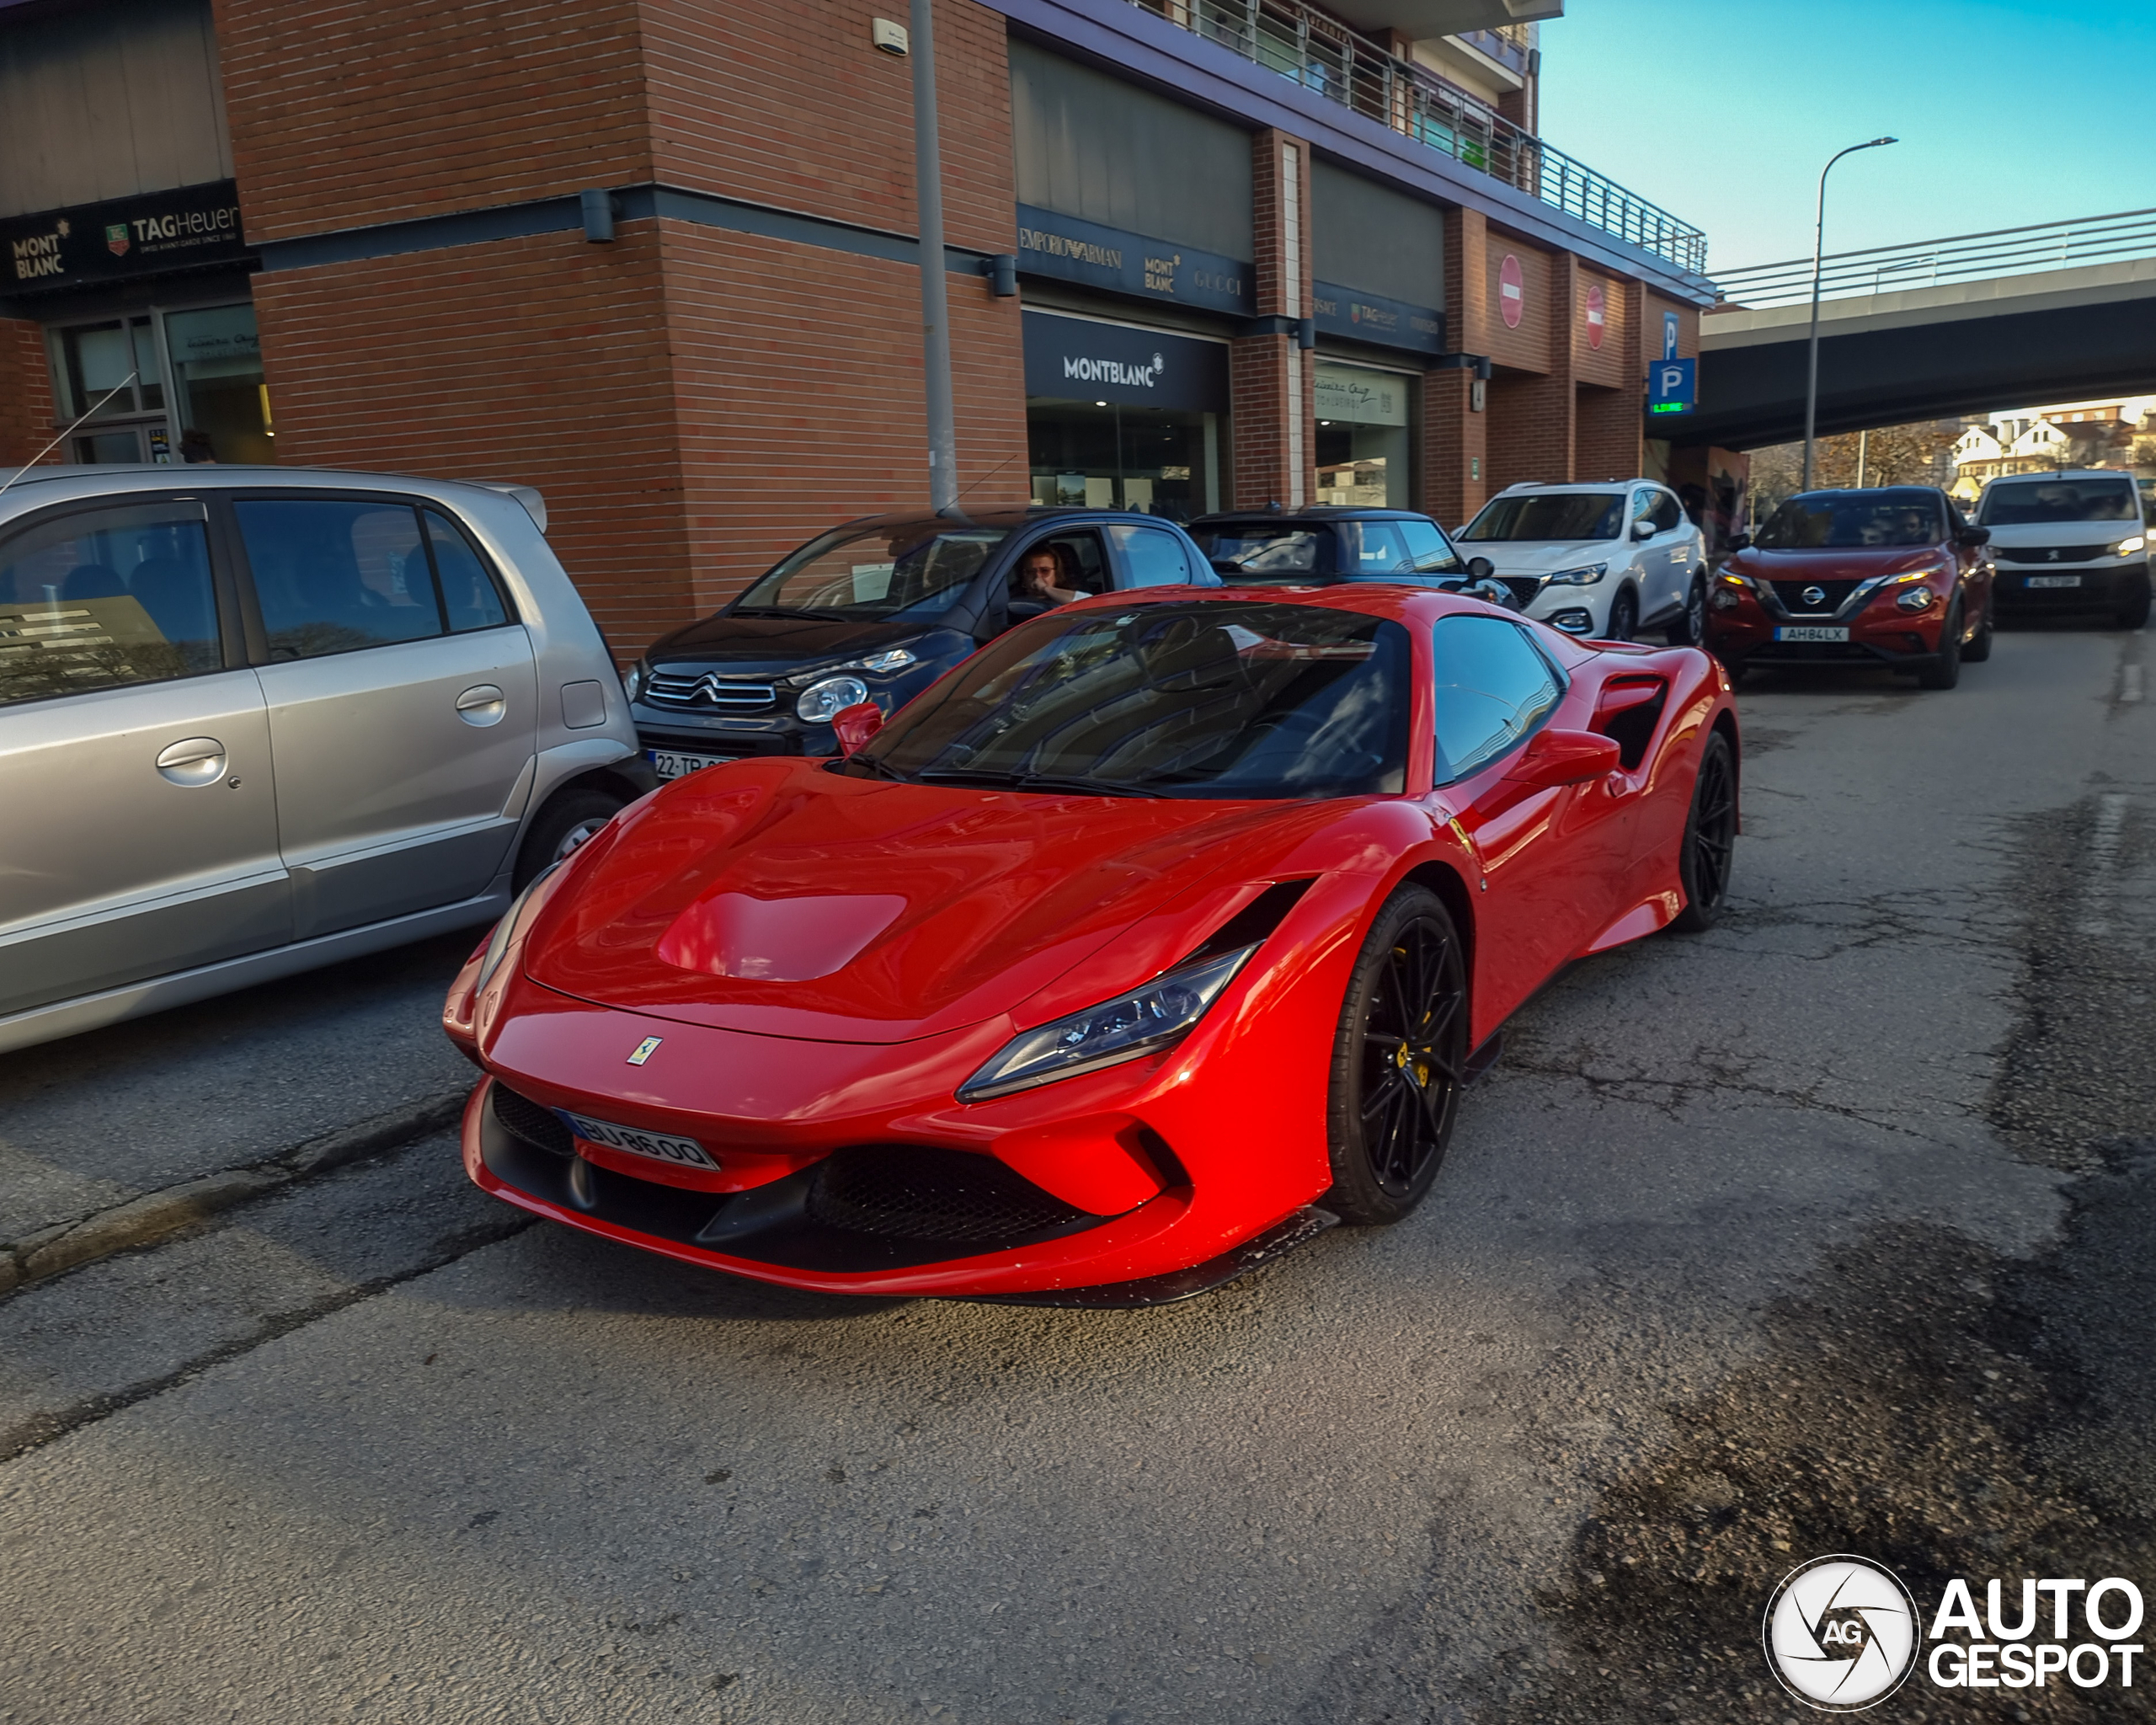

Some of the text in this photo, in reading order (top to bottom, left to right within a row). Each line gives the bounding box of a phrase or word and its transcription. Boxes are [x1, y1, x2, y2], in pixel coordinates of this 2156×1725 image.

[12, 234, 58, 259] MONT
[1020, 227, 1122, 270] EMPORIO ARMANI
[16, 254, 64, 279] BLANC
[1145, 257, 1173, 276] MONT
[1145, 275, 1174, 293] BLANC
[1313, 297, 1337, 317] RSACE
[1666, 322, 1676, 360] P
[1064, 355, 1155, 387] MONTBLANC
[1662, 371, 1683, 398] P
